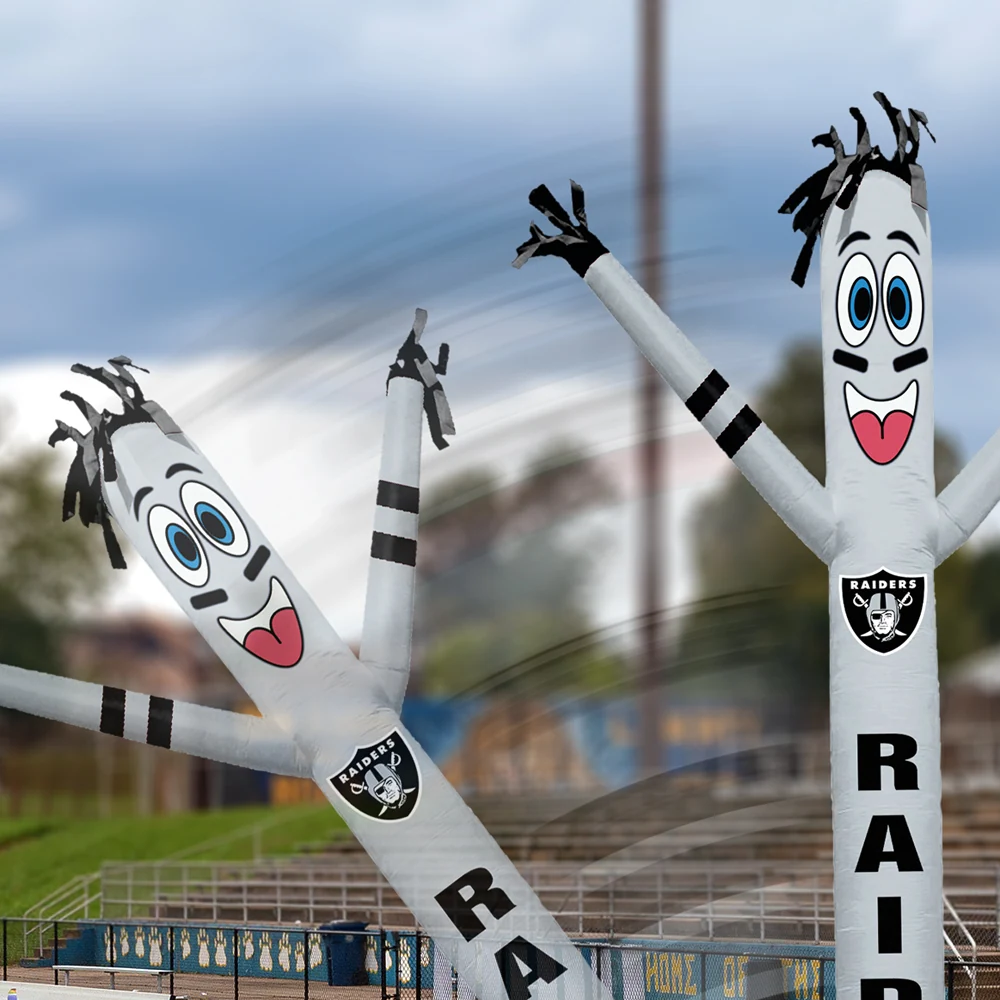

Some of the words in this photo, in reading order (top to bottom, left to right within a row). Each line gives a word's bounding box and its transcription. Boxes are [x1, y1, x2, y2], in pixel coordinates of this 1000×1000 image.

[850, 579, 917, 590] RAIDERS
[338, 738, 396, 784] RAIDERS
[646, 952, 697, 995] HOME
